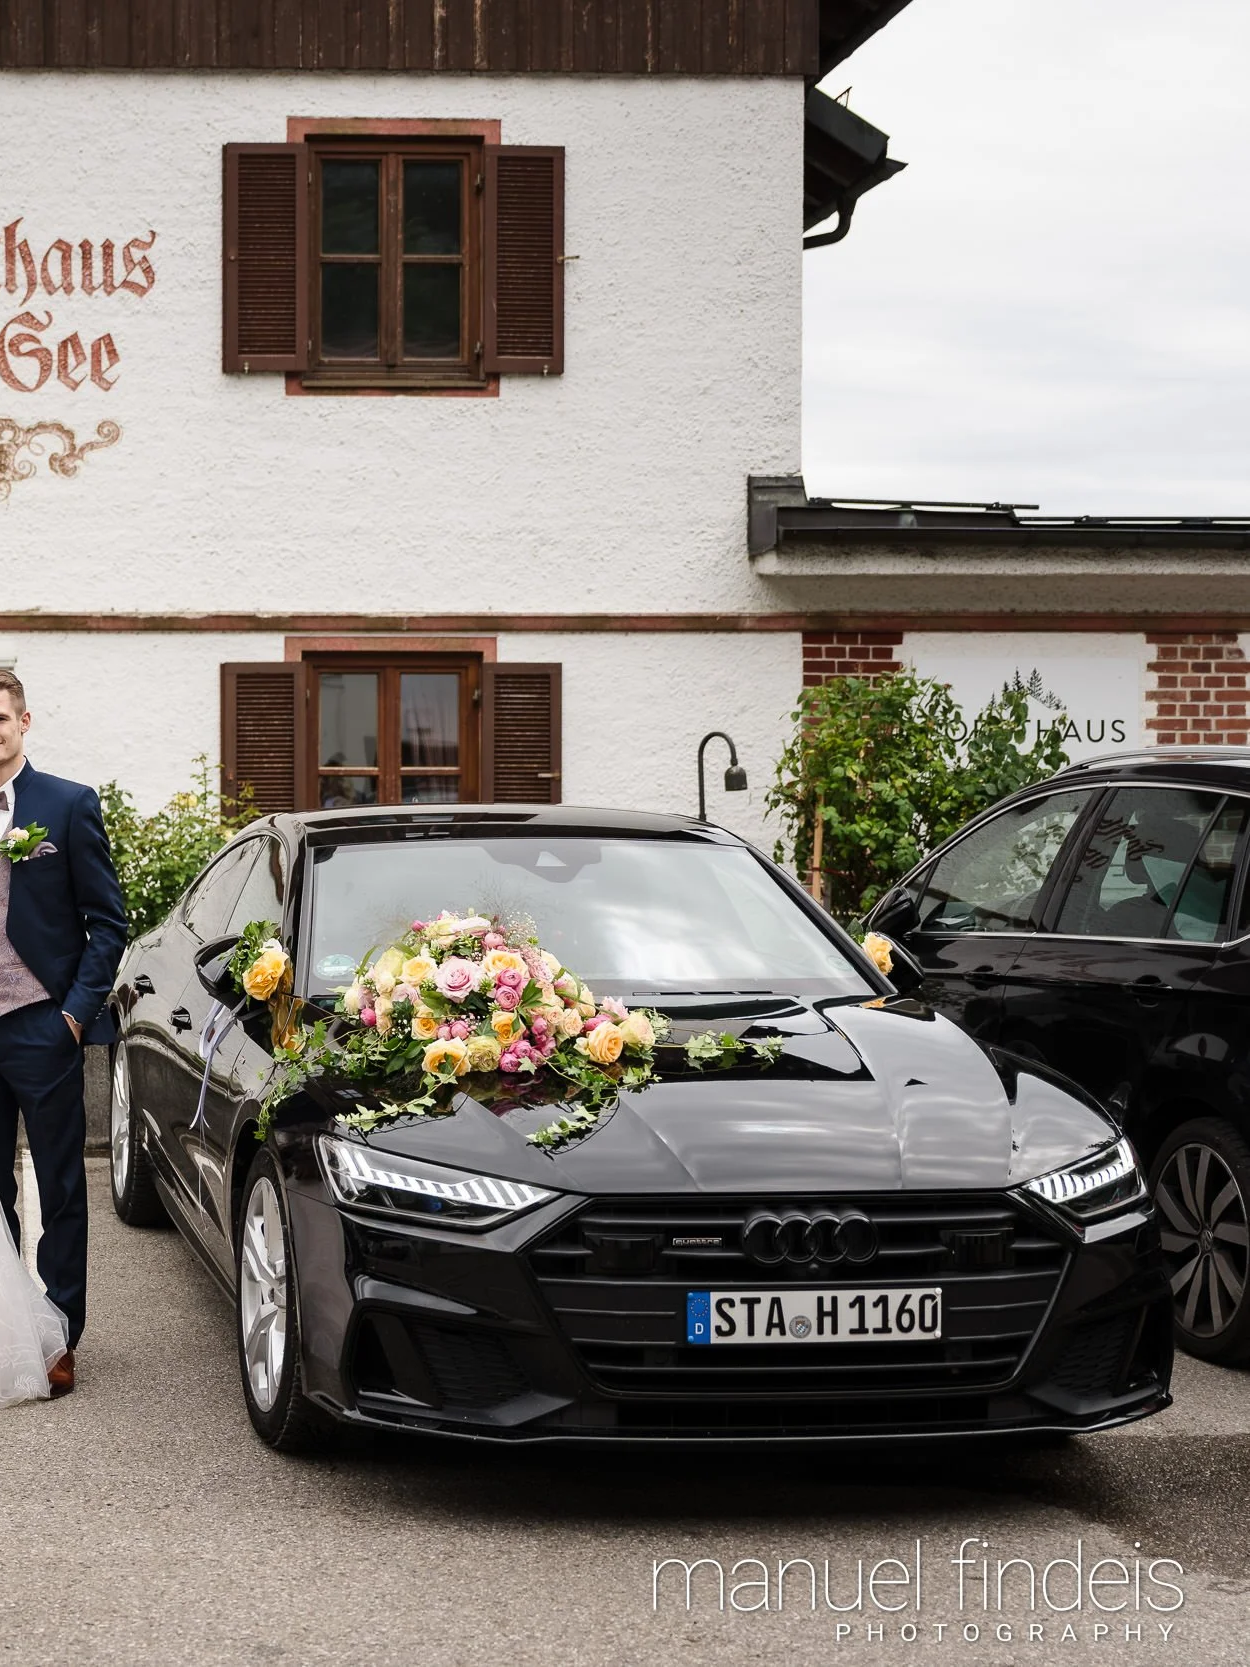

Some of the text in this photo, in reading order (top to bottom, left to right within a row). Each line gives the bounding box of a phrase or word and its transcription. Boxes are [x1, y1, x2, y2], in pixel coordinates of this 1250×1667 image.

[694, 1322, 704, 1335] D
[714, 1297, 787, 1338] STA
[816, 1296, 839, 1335] H
[849, 1293, 939, 1335] 1160
